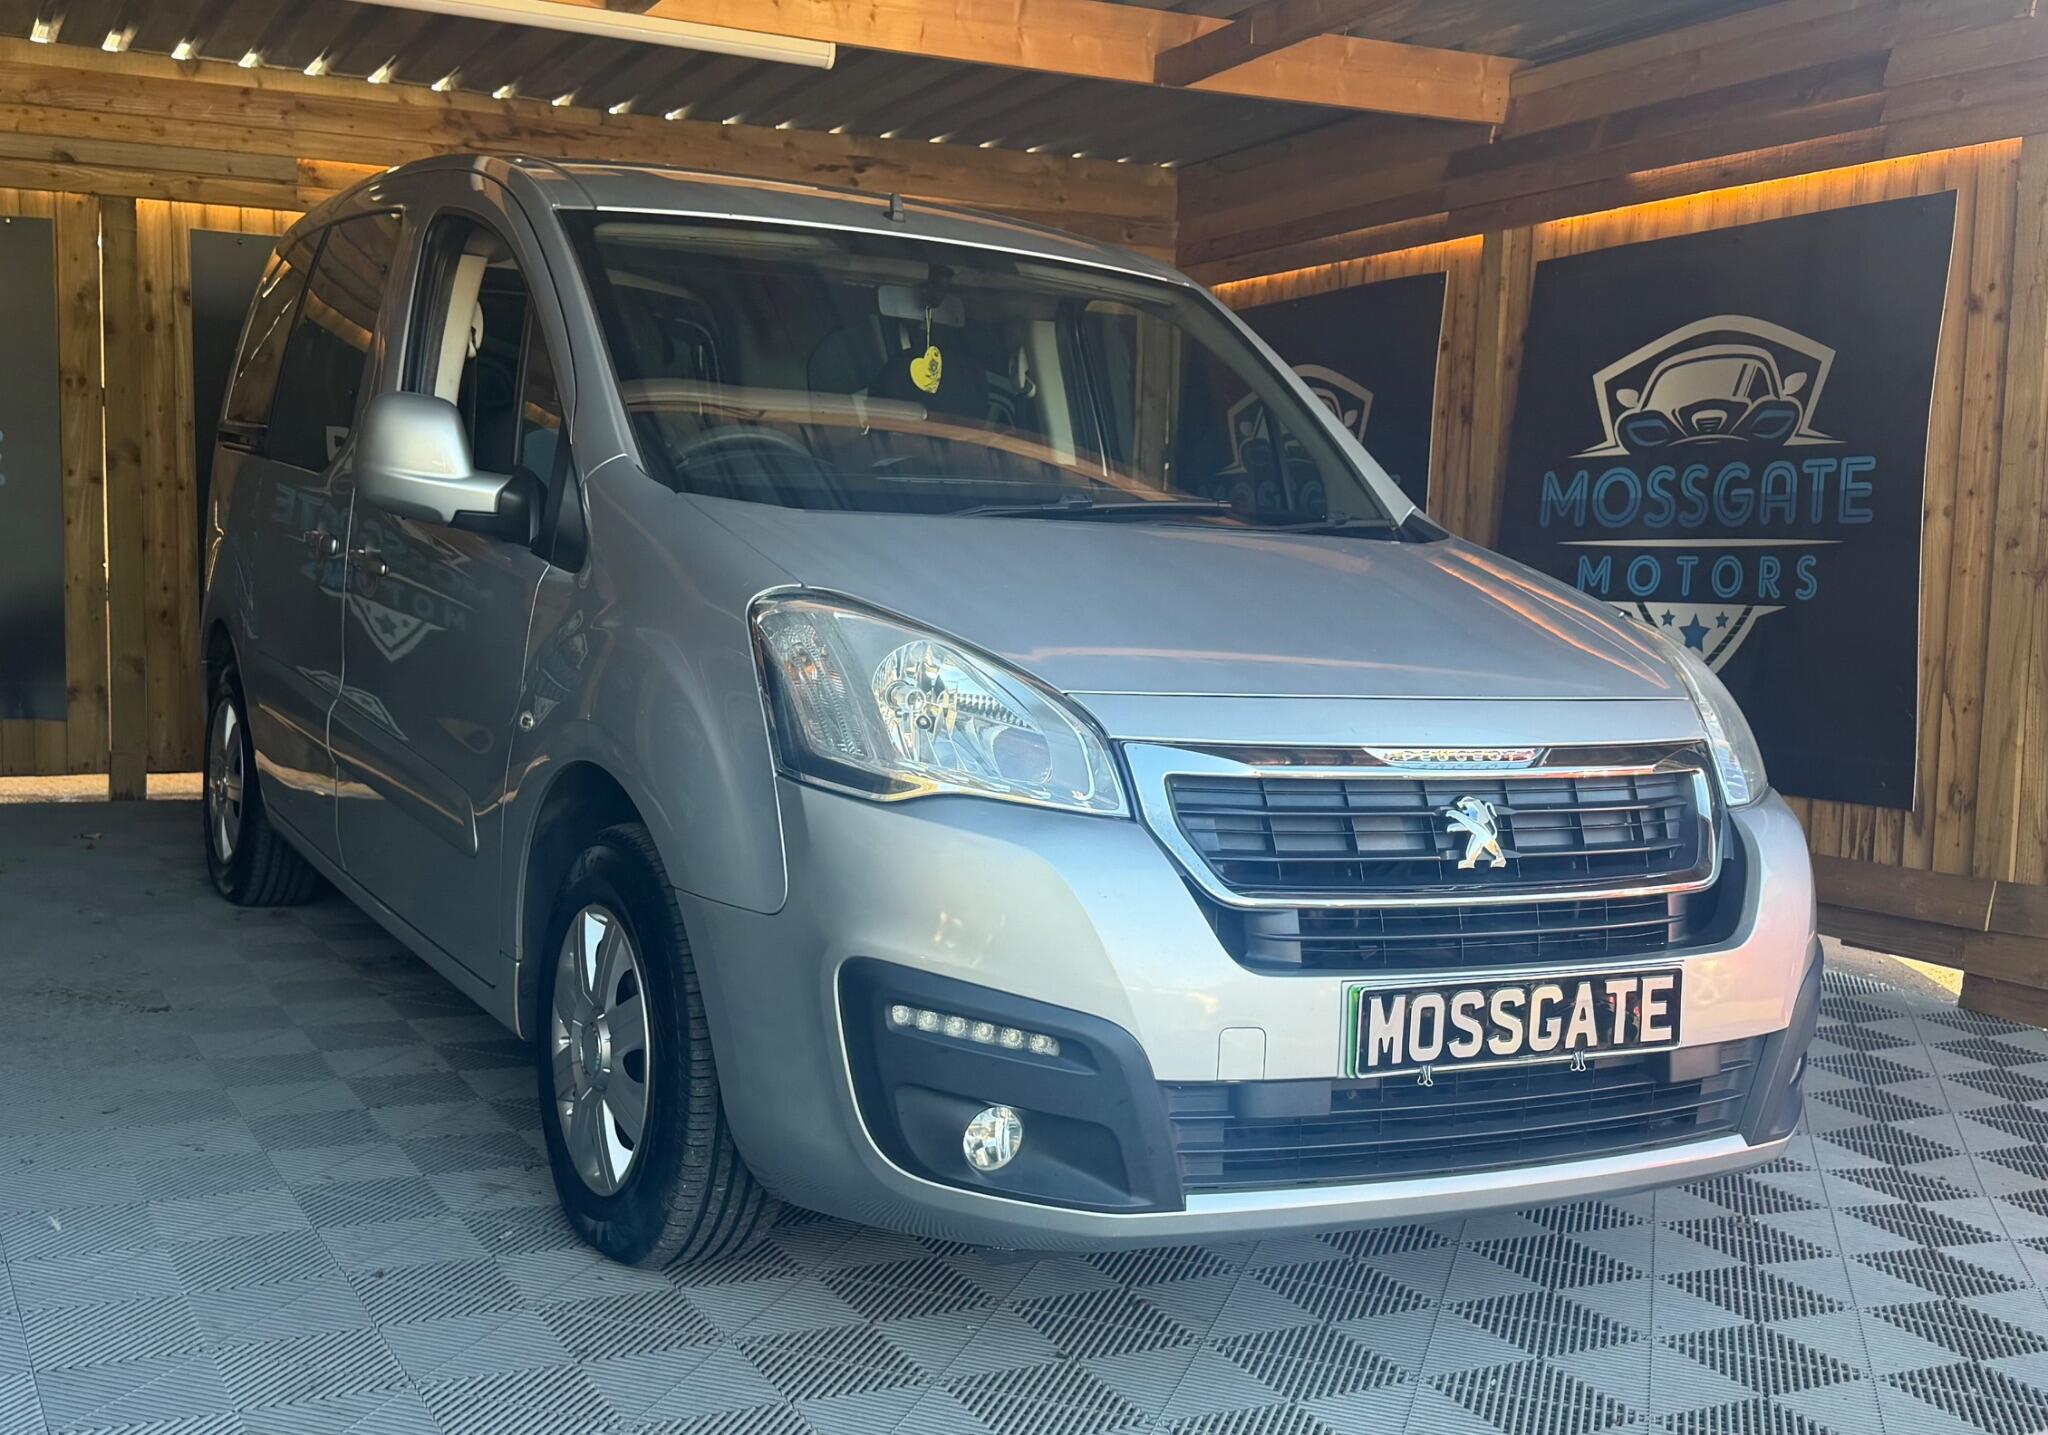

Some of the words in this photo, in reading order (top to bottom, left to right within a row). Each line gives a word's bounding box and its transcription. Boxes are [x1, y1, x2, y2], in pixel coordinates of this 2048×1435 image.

[1540, 456, 1876, 528] MOSSGATE
[1577, 555, 1818, 600] MOTORS
[1403, 750, 1516, 761] PEUGEOT
[1368, 976, 1675, 1066] MOSSGATE
